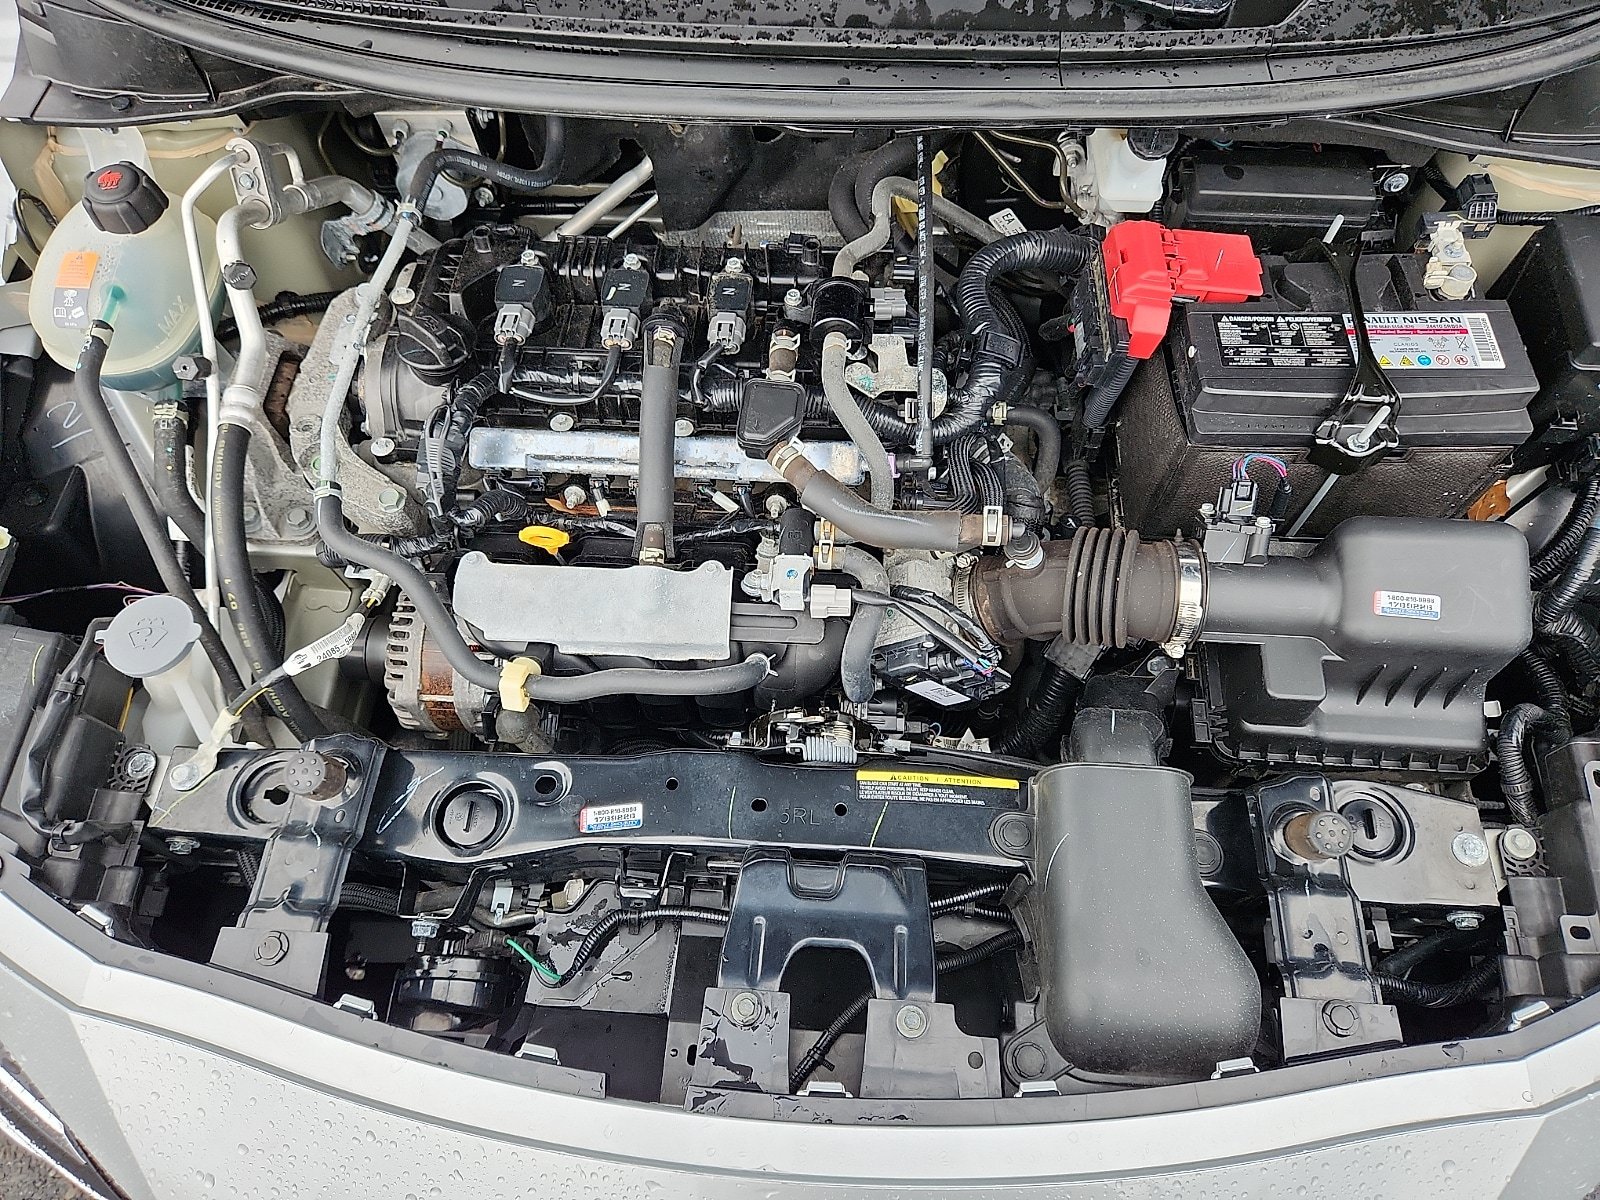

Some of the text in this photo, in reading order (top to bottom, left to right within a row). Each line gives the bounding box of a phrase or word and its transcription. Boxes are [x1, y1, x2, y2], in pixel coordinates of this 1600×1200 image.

[1002, 213, 1015, 224] EA
[1402, 316, 1462, 324] NISSAN
[944, 777, 982, 785] ATTENTION
[780, 807, 820, 825] 5RL
